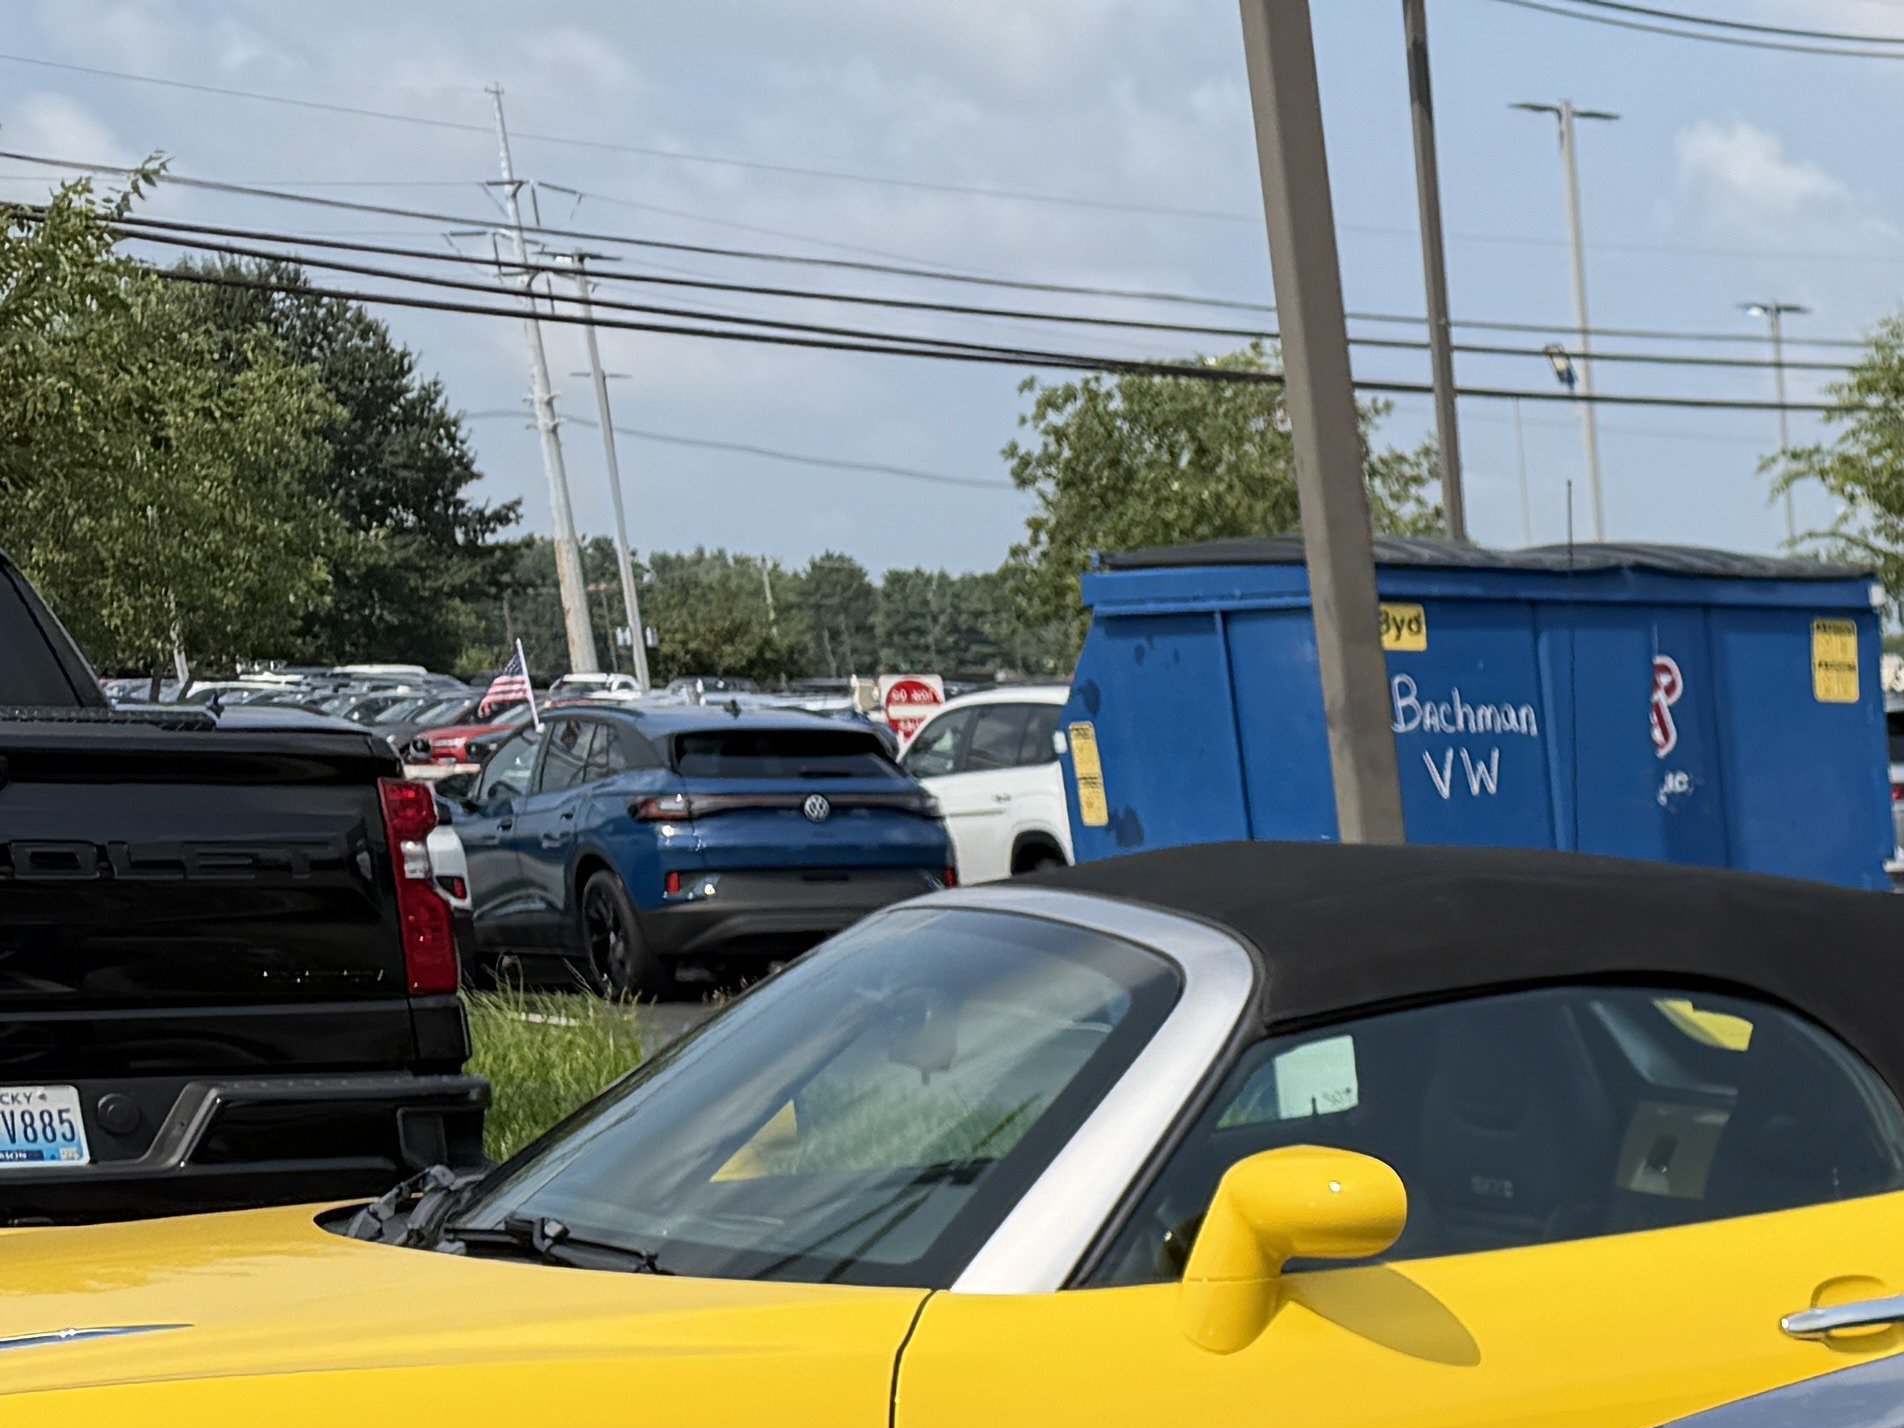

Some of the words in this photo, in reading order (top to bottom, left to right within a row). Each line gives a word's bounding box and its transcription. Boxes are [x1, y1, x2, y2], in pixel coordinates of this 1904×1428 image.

[1391, 672, 1538, 736] Bachman
[1422, 746, 1499, 799] VW
[0, 839, 345, 880] OLET
[0, 1108, 76, 1144] V885
